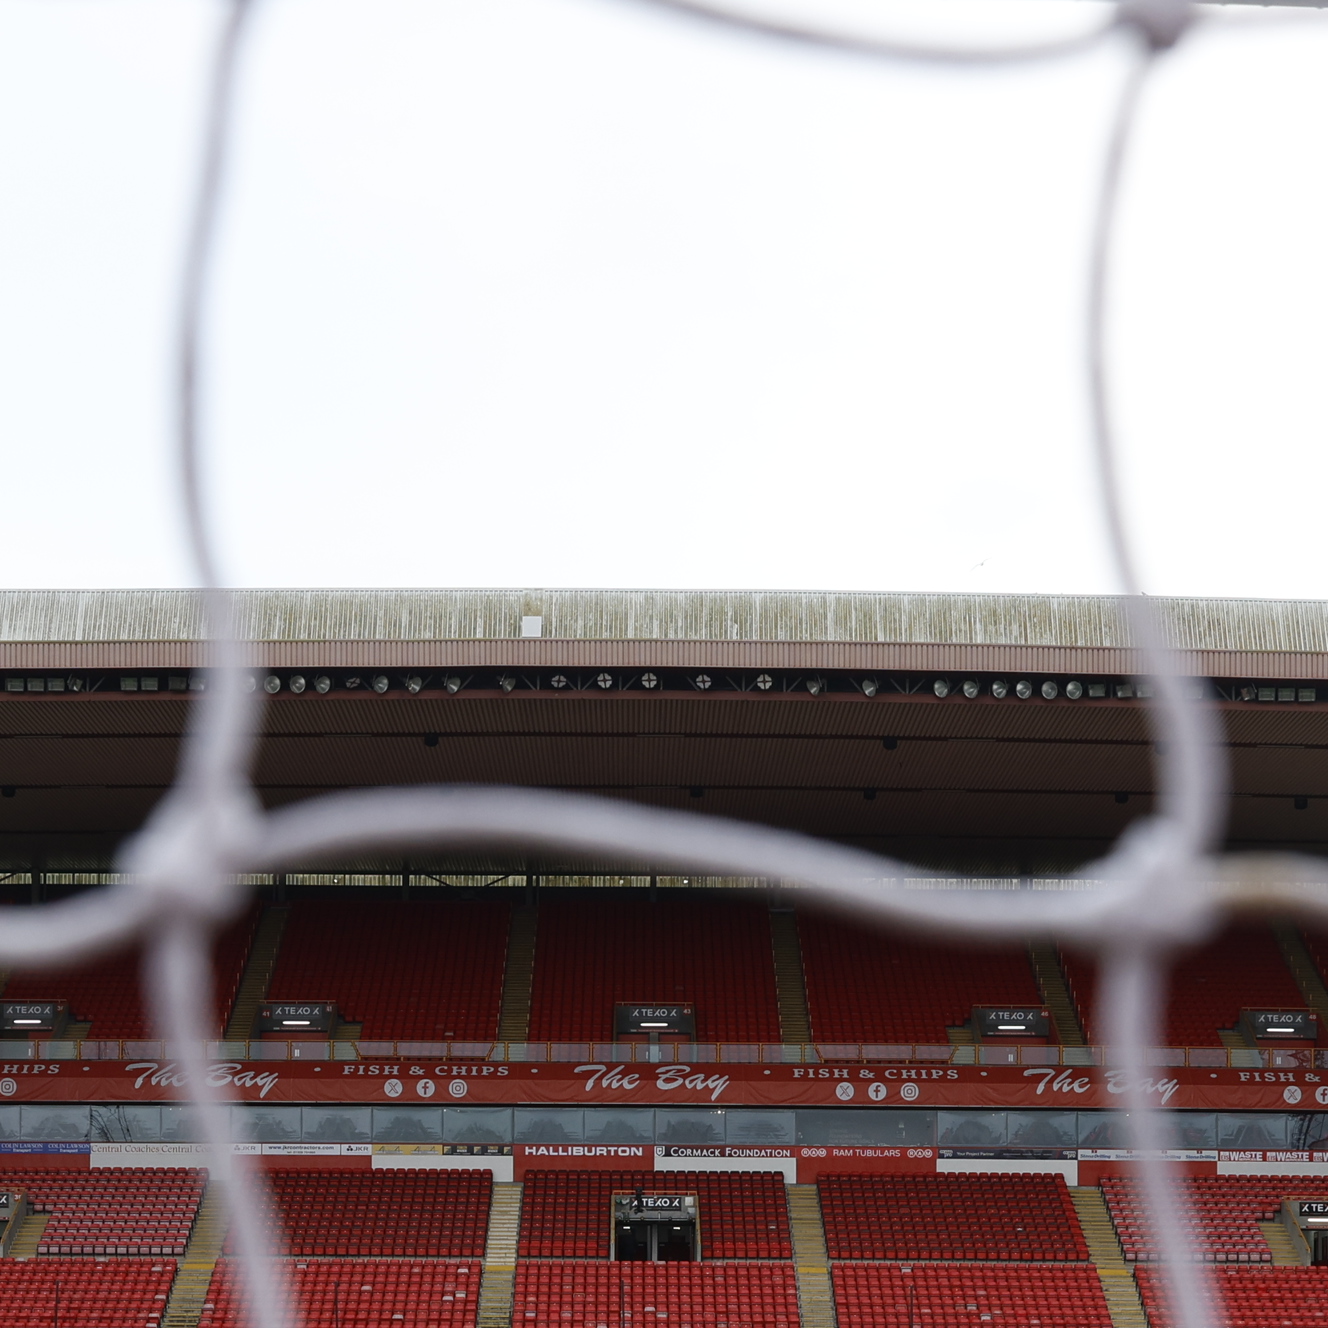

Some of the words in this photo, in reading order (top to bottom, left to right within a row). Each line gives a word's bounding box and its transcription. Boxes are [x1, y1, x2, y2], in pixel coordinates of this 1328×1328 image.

[15, 1006, 41, 1014] TEXO
[284, 1007, 310, 1015] TEXO
[641, 1009, 668, 1017] TEXO
[998, 1012, 1024, 1020] TEXO
[1267, 1014, 1293, 1022] TEXO
[342, 1065, 400, 1075] FISH
[408, 1065, 426, 1075] &
[434, 1066, 509, 1076] CHIPS
[792, 1068, 850, 1078] FISH
[859, 1069, 876, 1079] &
[884, 1069, 959, 1079] CHIPS
[205, 1062, 279, 1098] Bay
[1023, 1068, 1091, 1094] The
[1238, 1072, 1296, 1082] FISH
[1304, 1072, 1321, 1082] &
[574, 1065, 640, 1091] The
[655, 1065, 730, 1100] Bay
[91, 1144, 122, 1153] Central
[125, 1144, 159, 1153] Coaches
[161, 1145, 192, 1153] Central
[525, 1146, 643, 1156] HALLIBURTON
[833, 1149, 853, 1157] RAM
[854, 1149, 901, 1157] TUBULARS
[642, 1198, 670, 1207] TEXO
